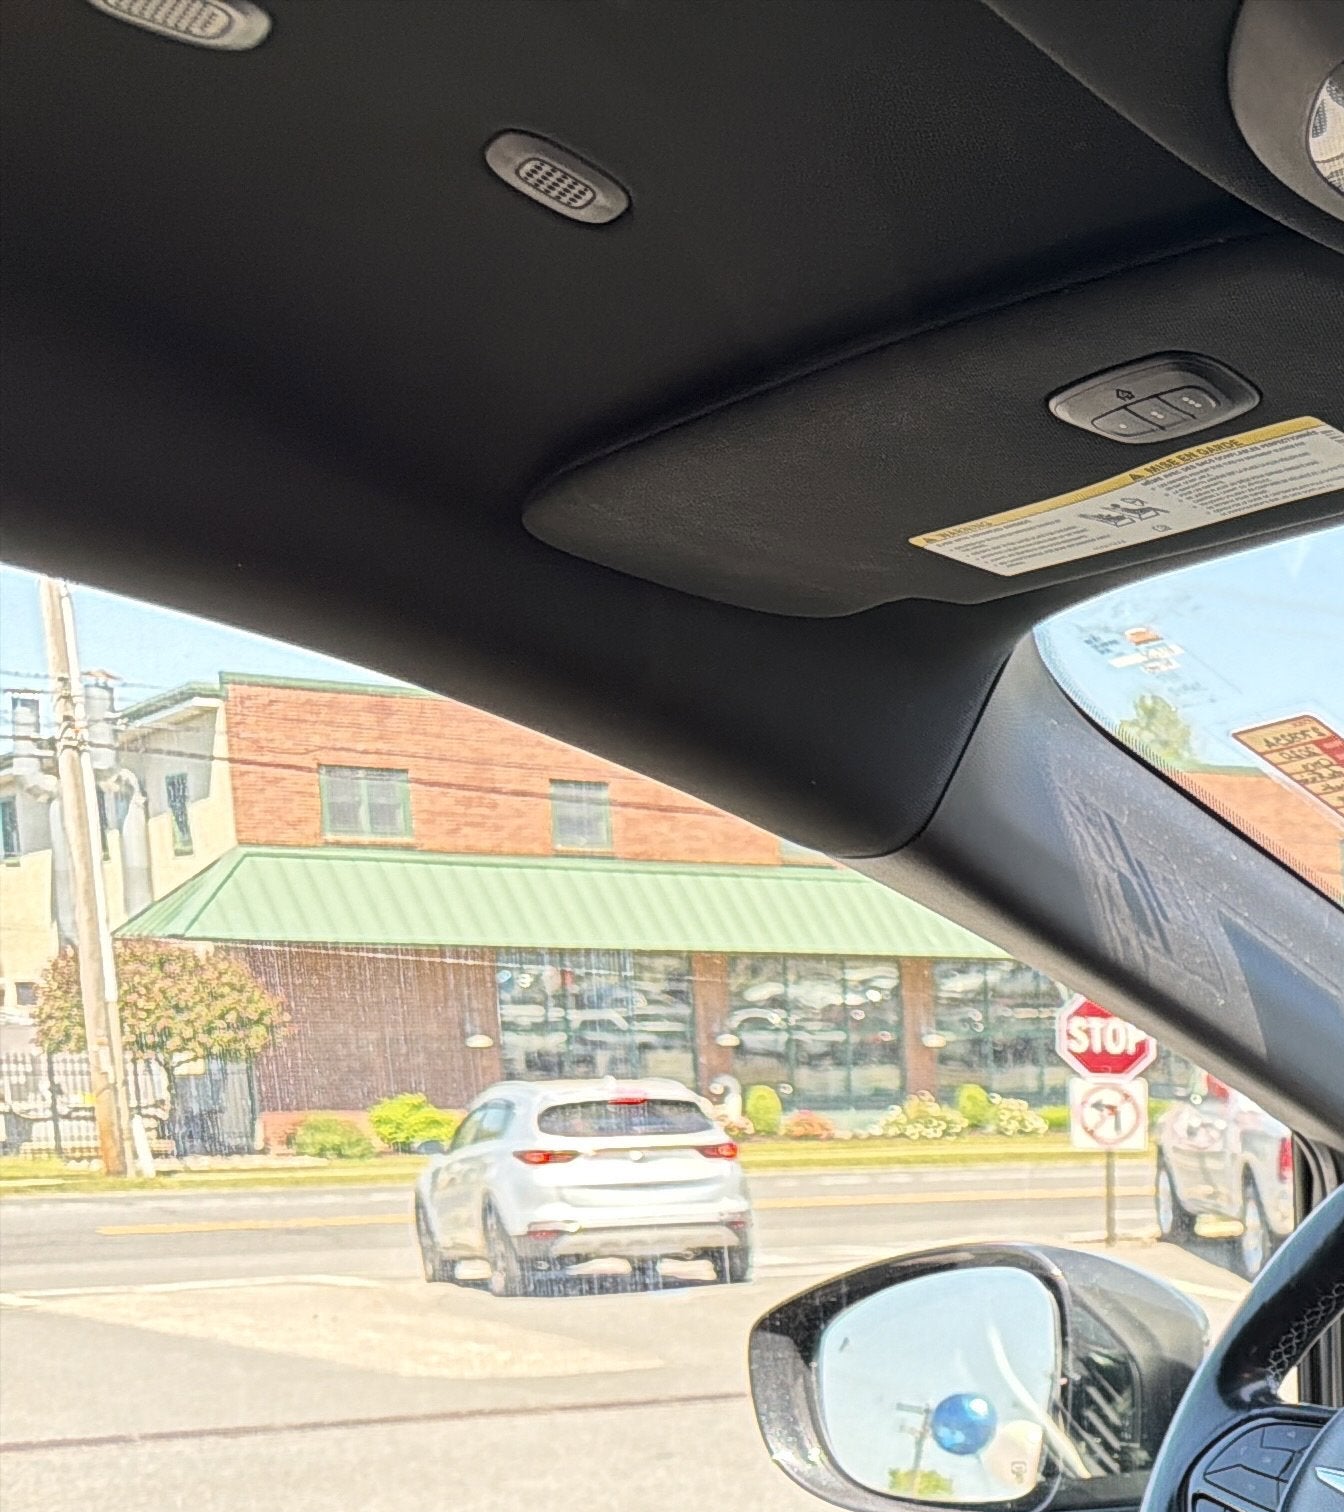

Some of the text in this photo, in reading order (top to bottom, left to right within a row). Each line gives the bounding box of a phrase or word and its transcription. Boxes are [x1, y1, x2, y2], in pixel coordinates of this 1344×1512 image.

[1143, 438, 1246, 474] MISE EN GARDE
[1067, 1016, 1147, 1055] STOP
